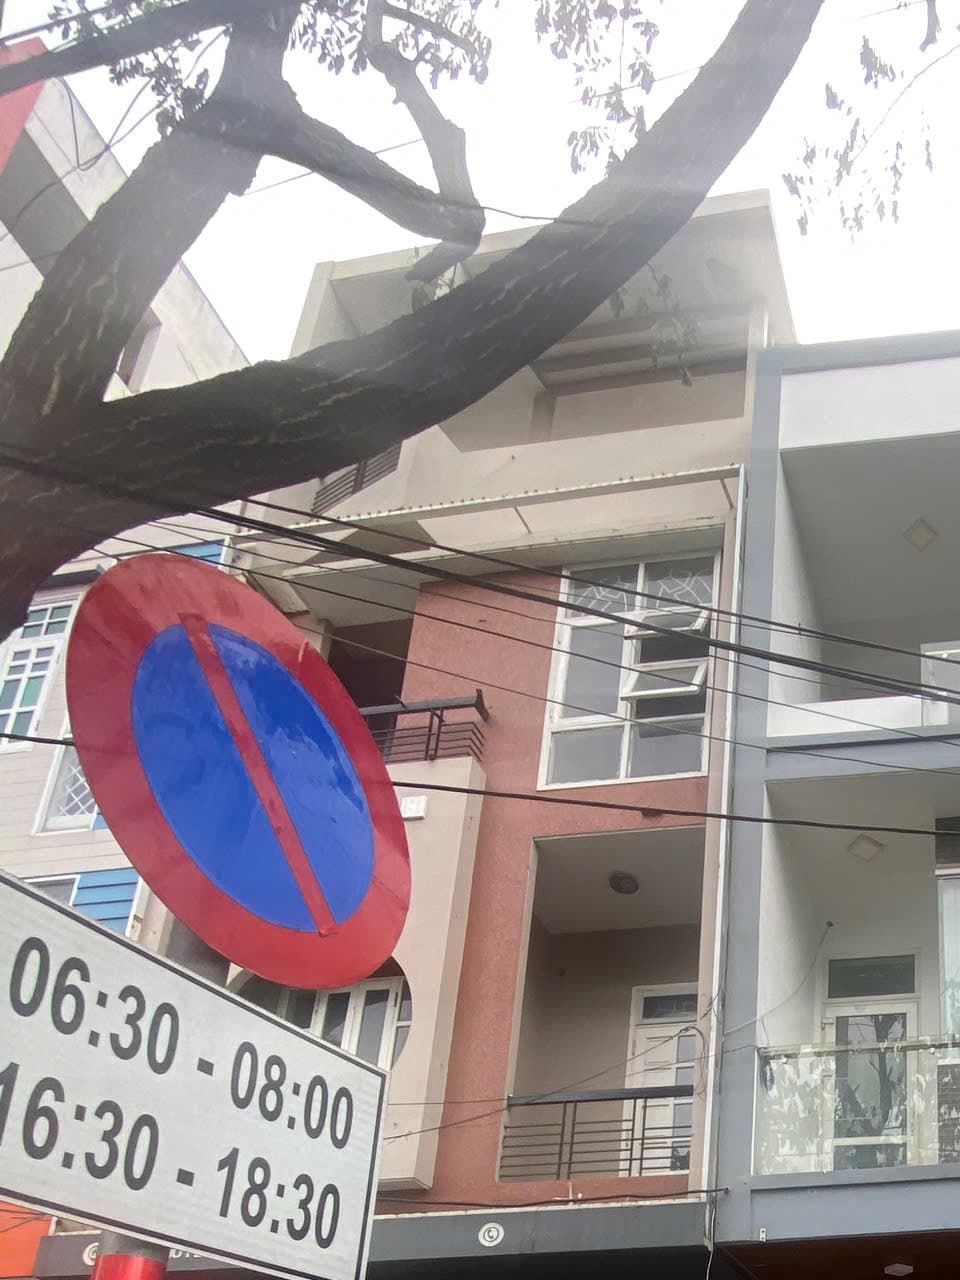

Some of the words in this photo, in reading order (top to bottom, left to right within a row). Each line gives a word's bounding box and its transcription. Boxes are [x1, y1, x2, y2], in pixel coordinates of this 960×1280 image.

[9, 936, 180, 1075] 06:30
[230, 1040, 354, 1150] 08:00
[217, 1146, 340, 1250] 18:30
